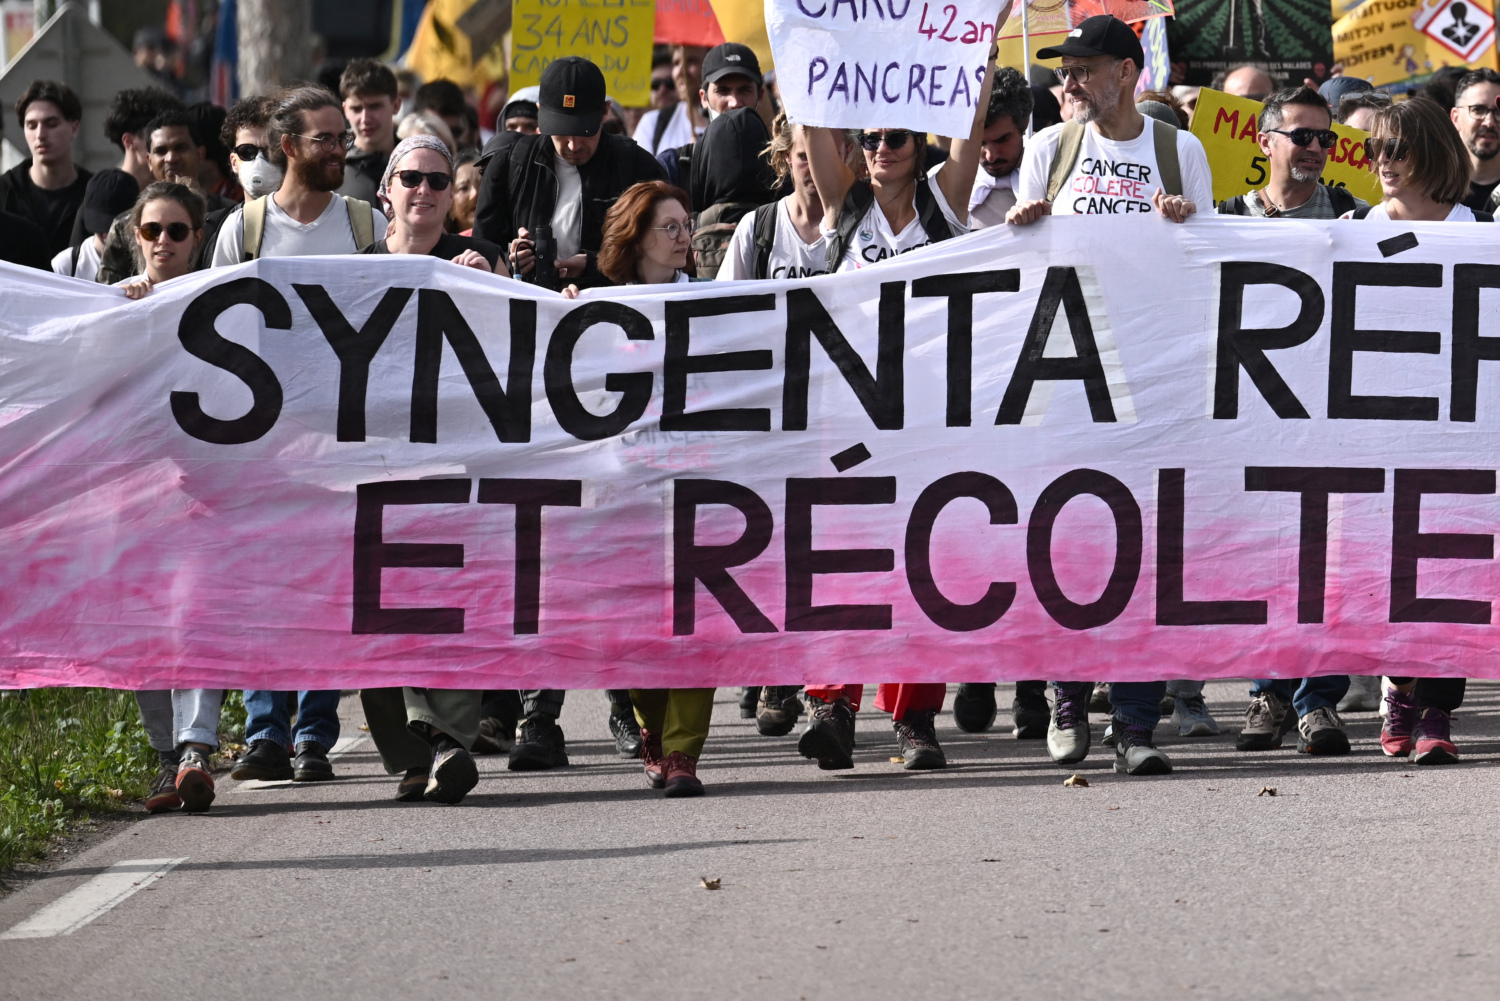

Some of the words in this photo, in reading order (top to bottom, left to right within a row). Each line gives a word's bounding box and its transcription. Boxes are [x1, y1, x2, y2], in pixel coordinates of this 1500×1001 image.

[516, 14, 561, 50] 34
[571, 16, 629, 47] ANS
[604, 54, 629, 72] DU
[1283, 61, 1312, 70] MALADES
[1213, 106, 1257, 144] MA
[1081, 158, 1152, 183] CANCER
[1073, 196, 1152, 214] CANCER
[170, 265, 1117, 444] SYNGENTA
[351, 478, 581, 635] ET
[673, 443, 1496, 636] RÉCOLTE
